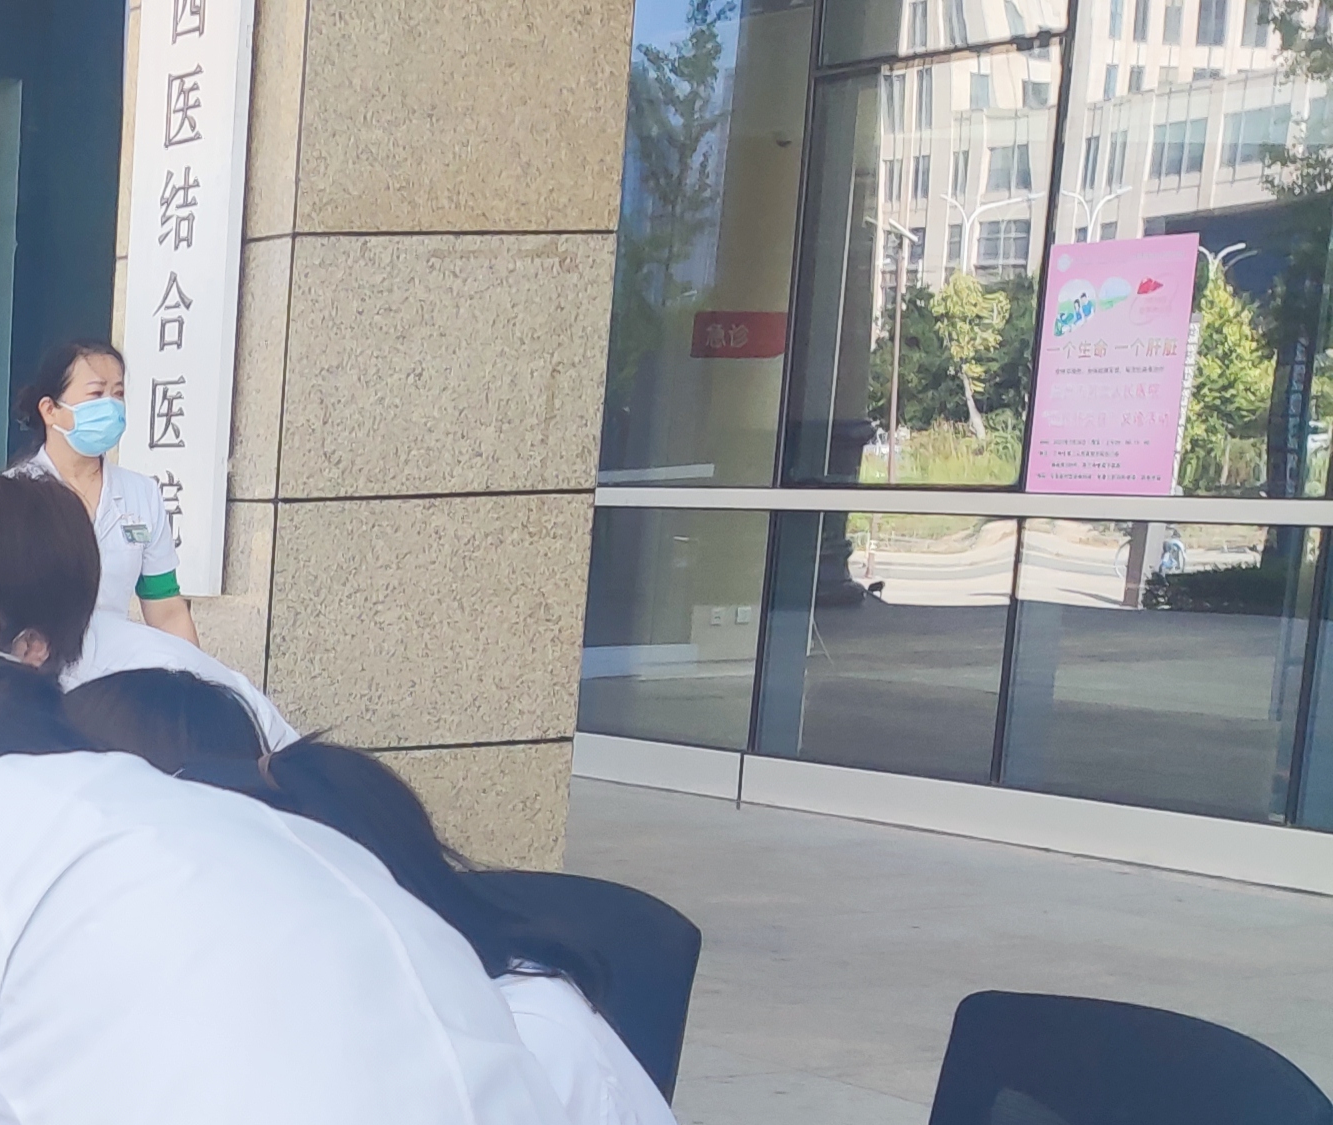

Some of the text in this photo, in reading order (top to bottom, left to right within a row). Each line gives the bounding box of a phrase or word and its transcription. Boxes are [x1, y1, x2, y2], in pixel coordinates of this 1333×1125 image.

[1046, 336, 1179, 360] 一个生命 一个肝脏
